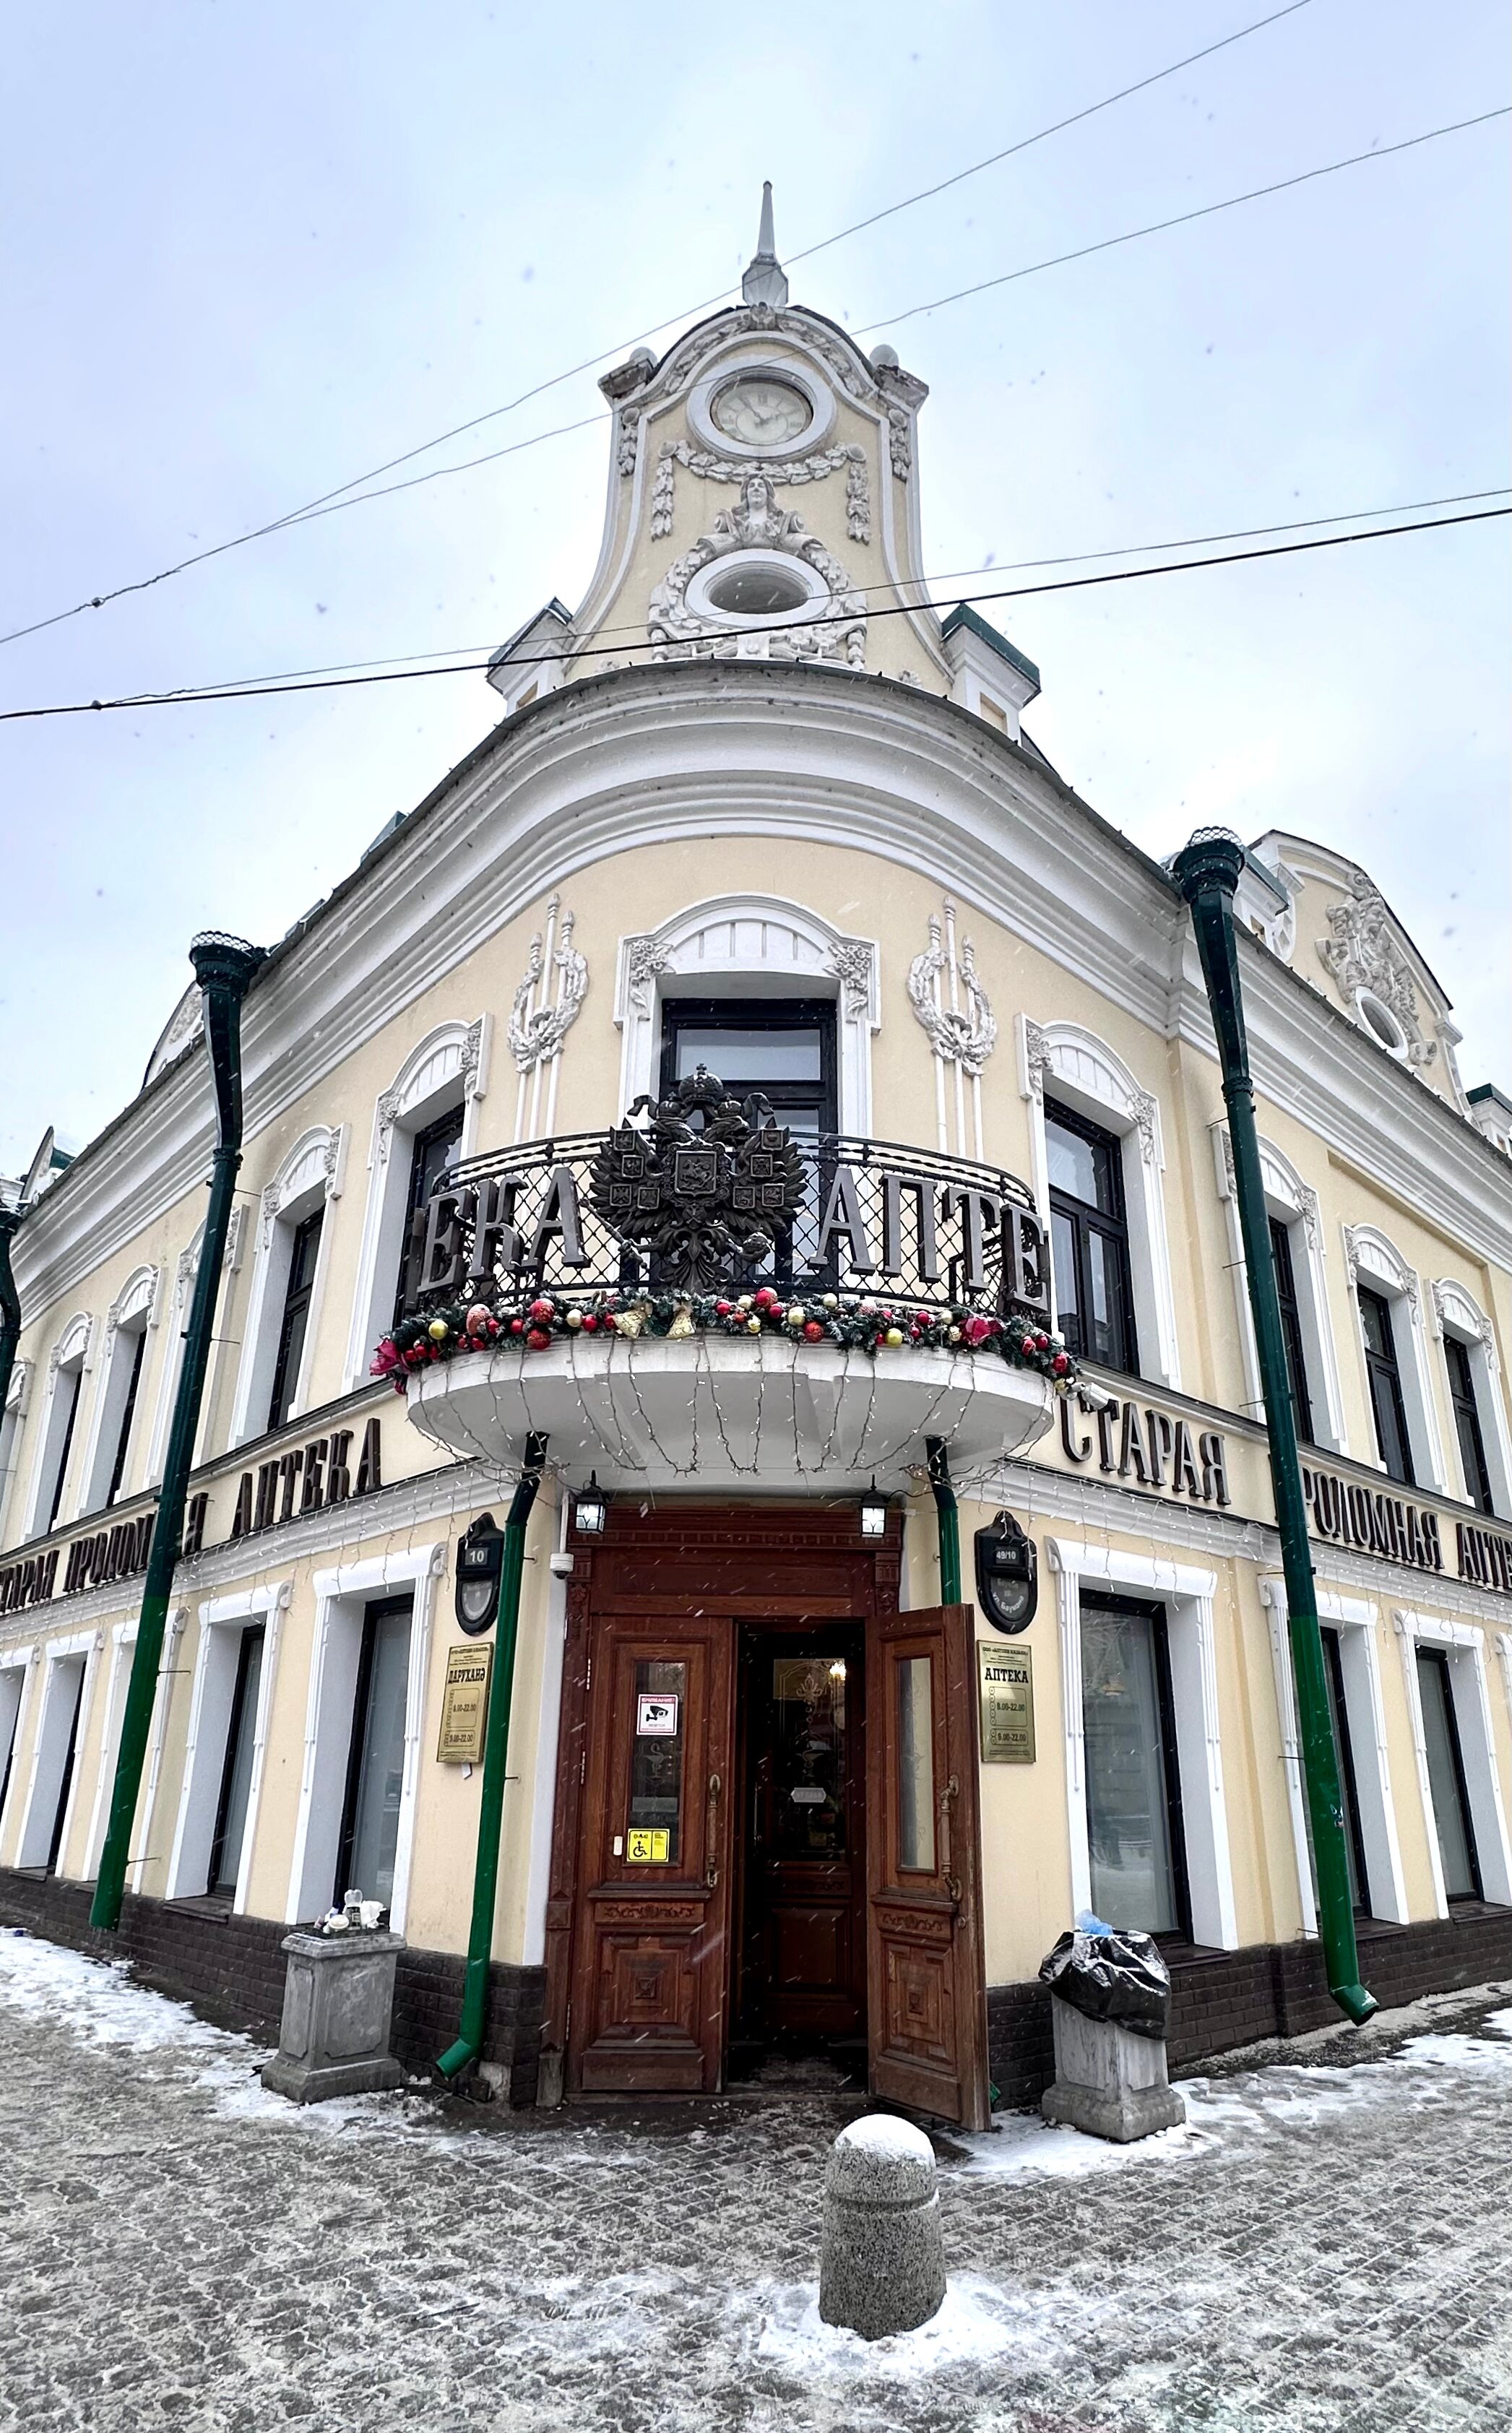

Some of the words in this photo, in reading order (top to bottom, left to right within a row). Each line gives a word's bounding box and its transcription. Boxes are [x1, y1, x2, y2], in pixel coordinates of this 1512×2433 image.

[230, 1417, 383, 1540] АПТЕКА
[1058, 1392, 1232, 1505] СТАРАЯ
[1268, 1453, 1445, 1570] РОЛОМНАЯ
[470, 1550, 485, 1563] 10
[995, 1550, 1017, 1560] 49/10
[984, 1667, 1029, 1684] АПТЕКА
